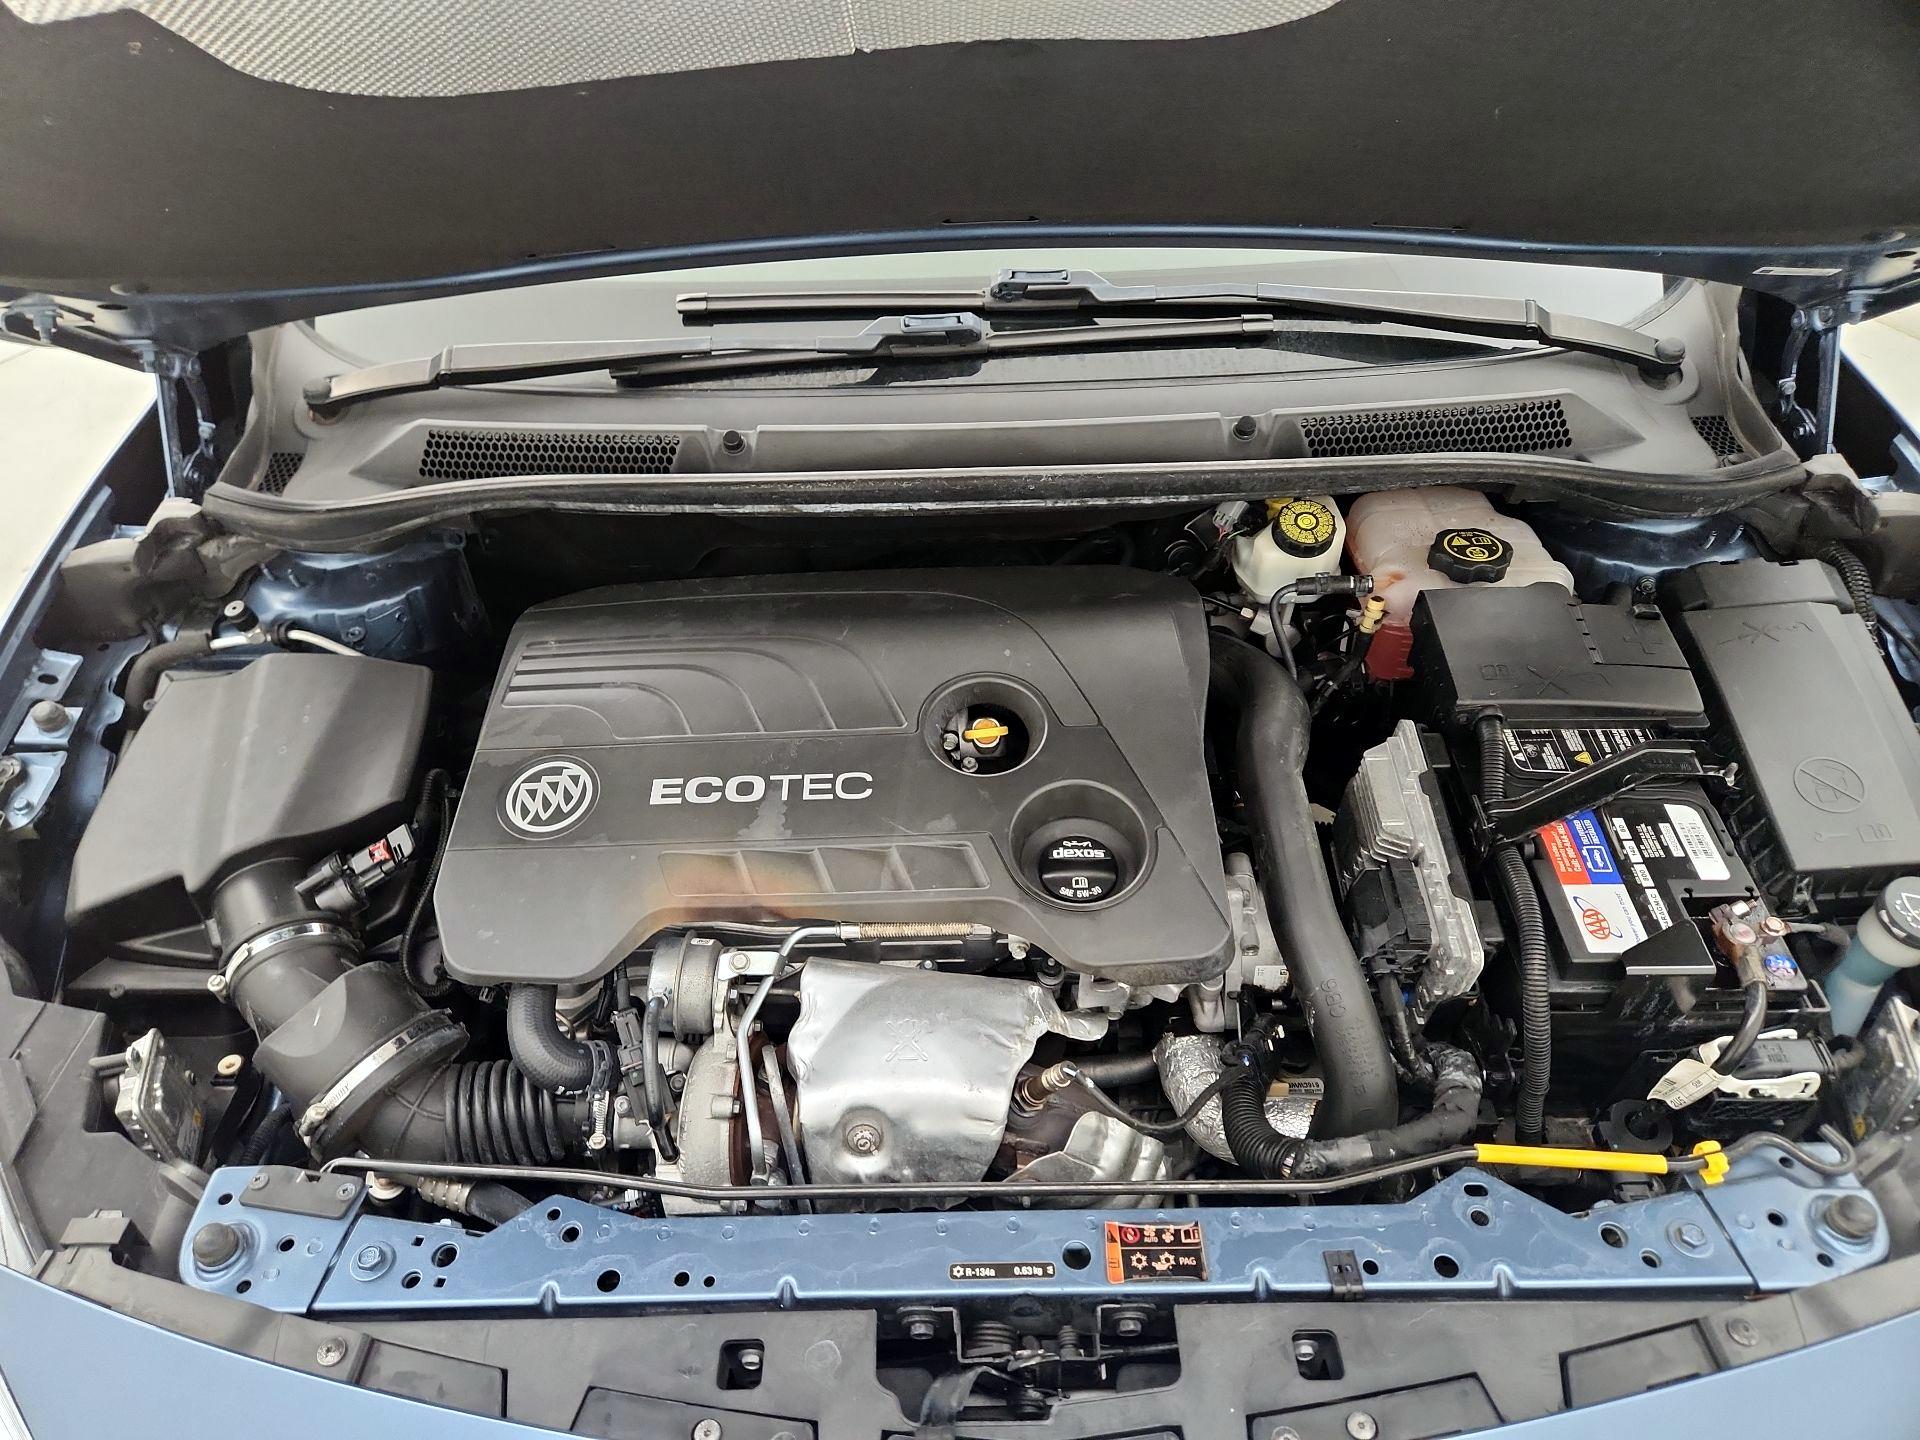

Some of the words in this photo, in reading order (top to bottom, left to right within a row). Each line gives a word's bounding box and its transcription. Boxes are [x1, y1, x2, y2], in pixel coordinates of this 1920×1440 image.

[649, 772, 874, 805] ECOTEC
[1052, 847, 1105, 858] dexos
[1059, 886, 1074, 897] SAE
[1076, 886, 1102, 897] 5W-30
[1179, 1256, 1196, 1266] PAG
[965, 1267, 996, 1277] R-134a
[1013, 1265, 1032, 1276] 0.63
[1032, 1266, 1043, 1276] kg
